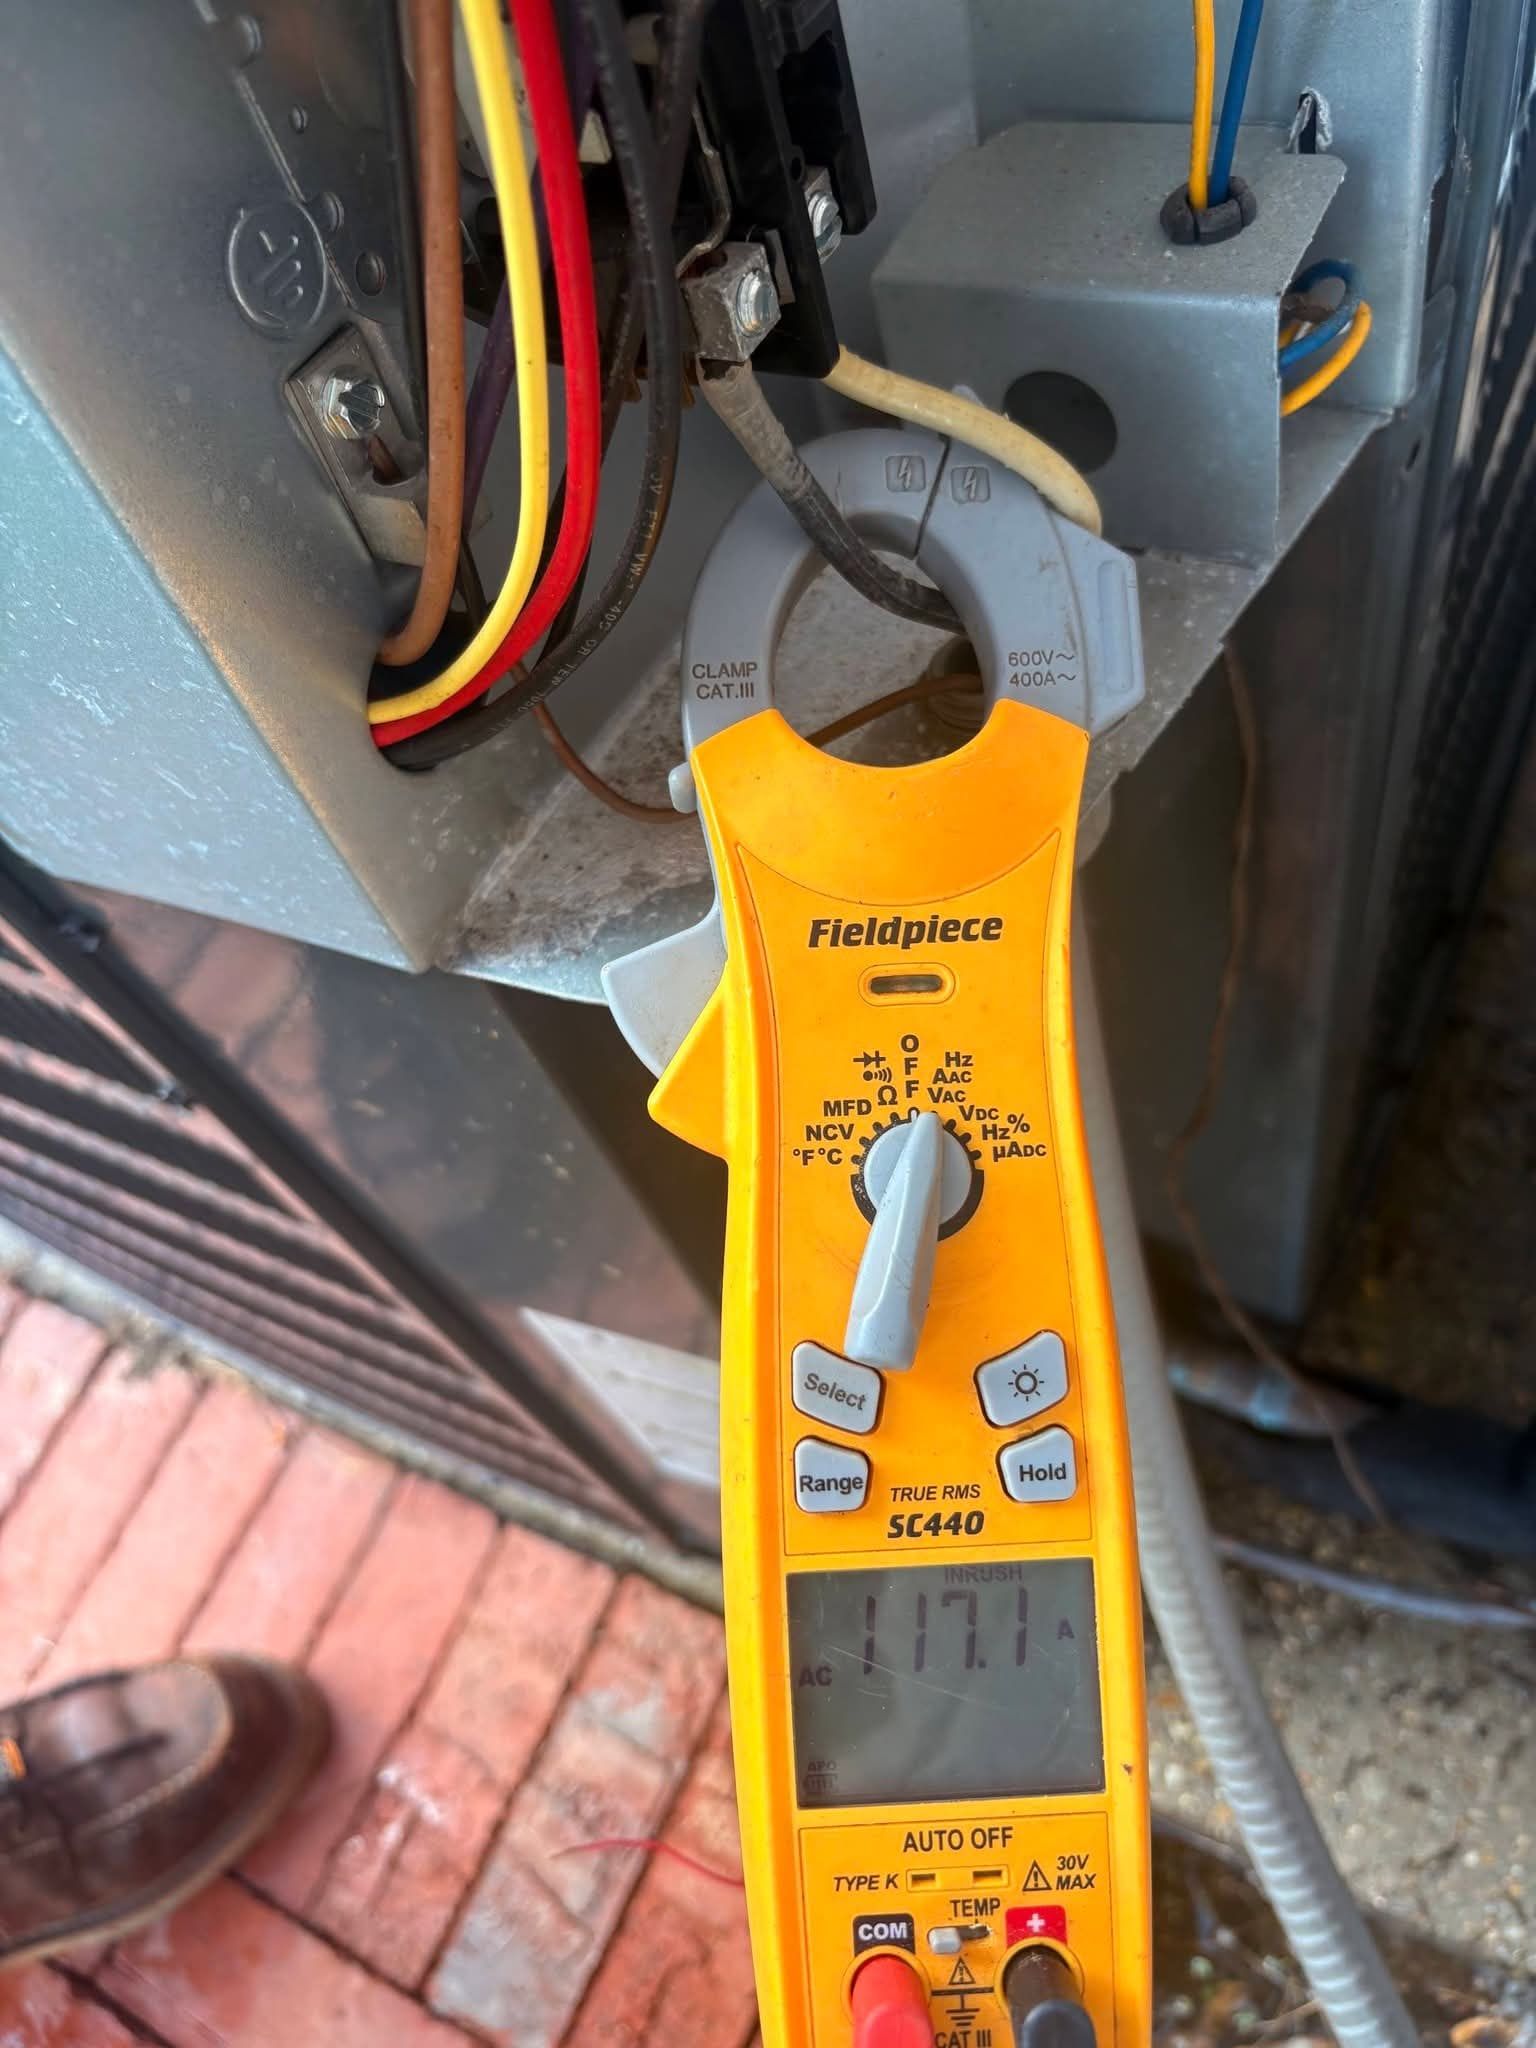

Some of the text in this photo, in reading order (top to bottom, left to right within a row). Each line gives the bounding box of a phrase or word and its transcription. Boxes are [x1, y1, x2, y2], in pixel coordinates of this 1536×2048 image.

[692, 661, 759, 681] CLAMP
[696, 682, 755, 700] CAT.III
[808, 915, 1003, 949] Fieldpiece
[945, 1051, 973, 1068] Hz
[823, 1099, 872, 1117] MFD
[805, 1123, 855, 1142] NCV
[804, 1372, 867, 1411] Select
[1019, 1462, 1067, 1483] Hold
[800, 1474, 864, 1495] Range
[890, 1484, 981, 1502] TRUE RMS
[887, 1510, 985, 1538] SC440
[944, 1564, 1023, 1584] INRUSH
[863, 1587, 1028, 1675] 117.1
[1057, 1618, 1075, 1640] A
[800, 1666, 833, 1687] AC
[903, 1826, 1014, 1853] AUTO OFF
[1056, 1854, 1089, 1870] 30V
[833, 1873, 900, 1892] TYPE K
[1055, 1873, 1097, 1890] MAX
[950, 1898, 1001, 1918] TEMP
[857, 1921, 908, 1941] COM
[935, 2029, 992, 2048] CAT III
